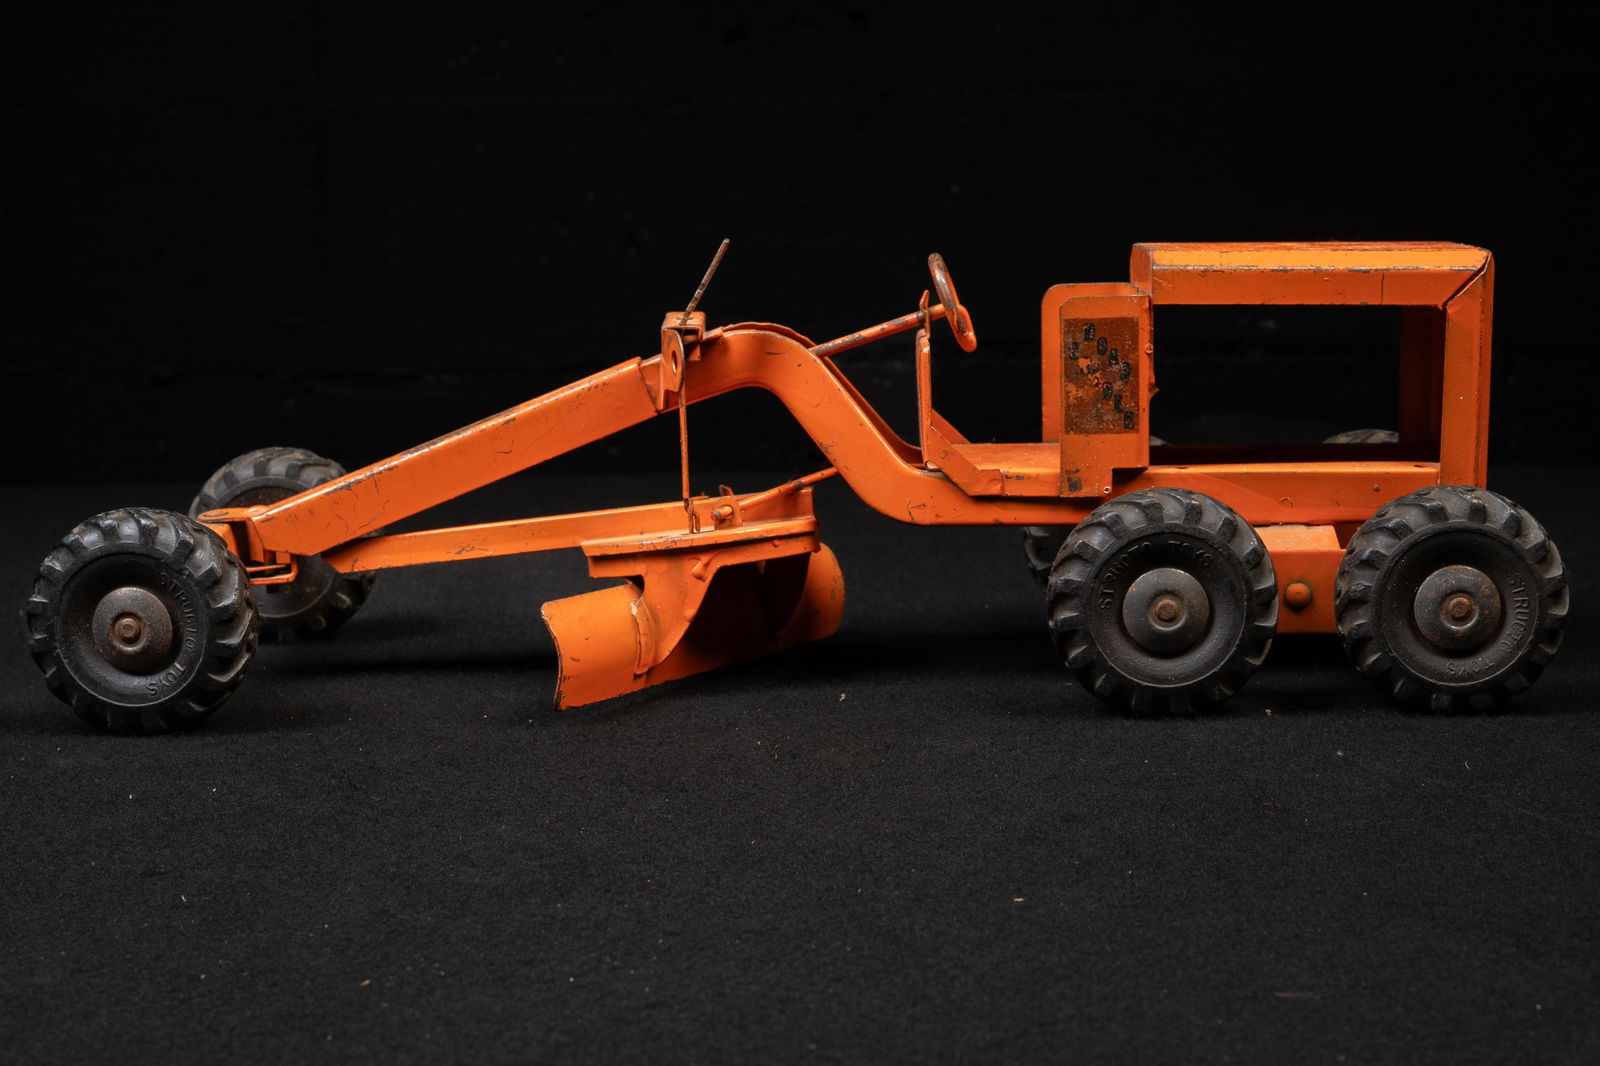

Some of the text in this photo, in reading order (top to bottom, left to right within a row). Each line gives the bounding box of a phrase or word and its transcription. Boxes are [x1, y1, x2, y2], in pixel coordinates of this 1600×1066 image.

[1097, 541, 1153, 609] STRUCTO
[1446, 571, 1531, 677] STRUCTO TOYS
[146, 570, 198, 697] STRUCTO TOYS
